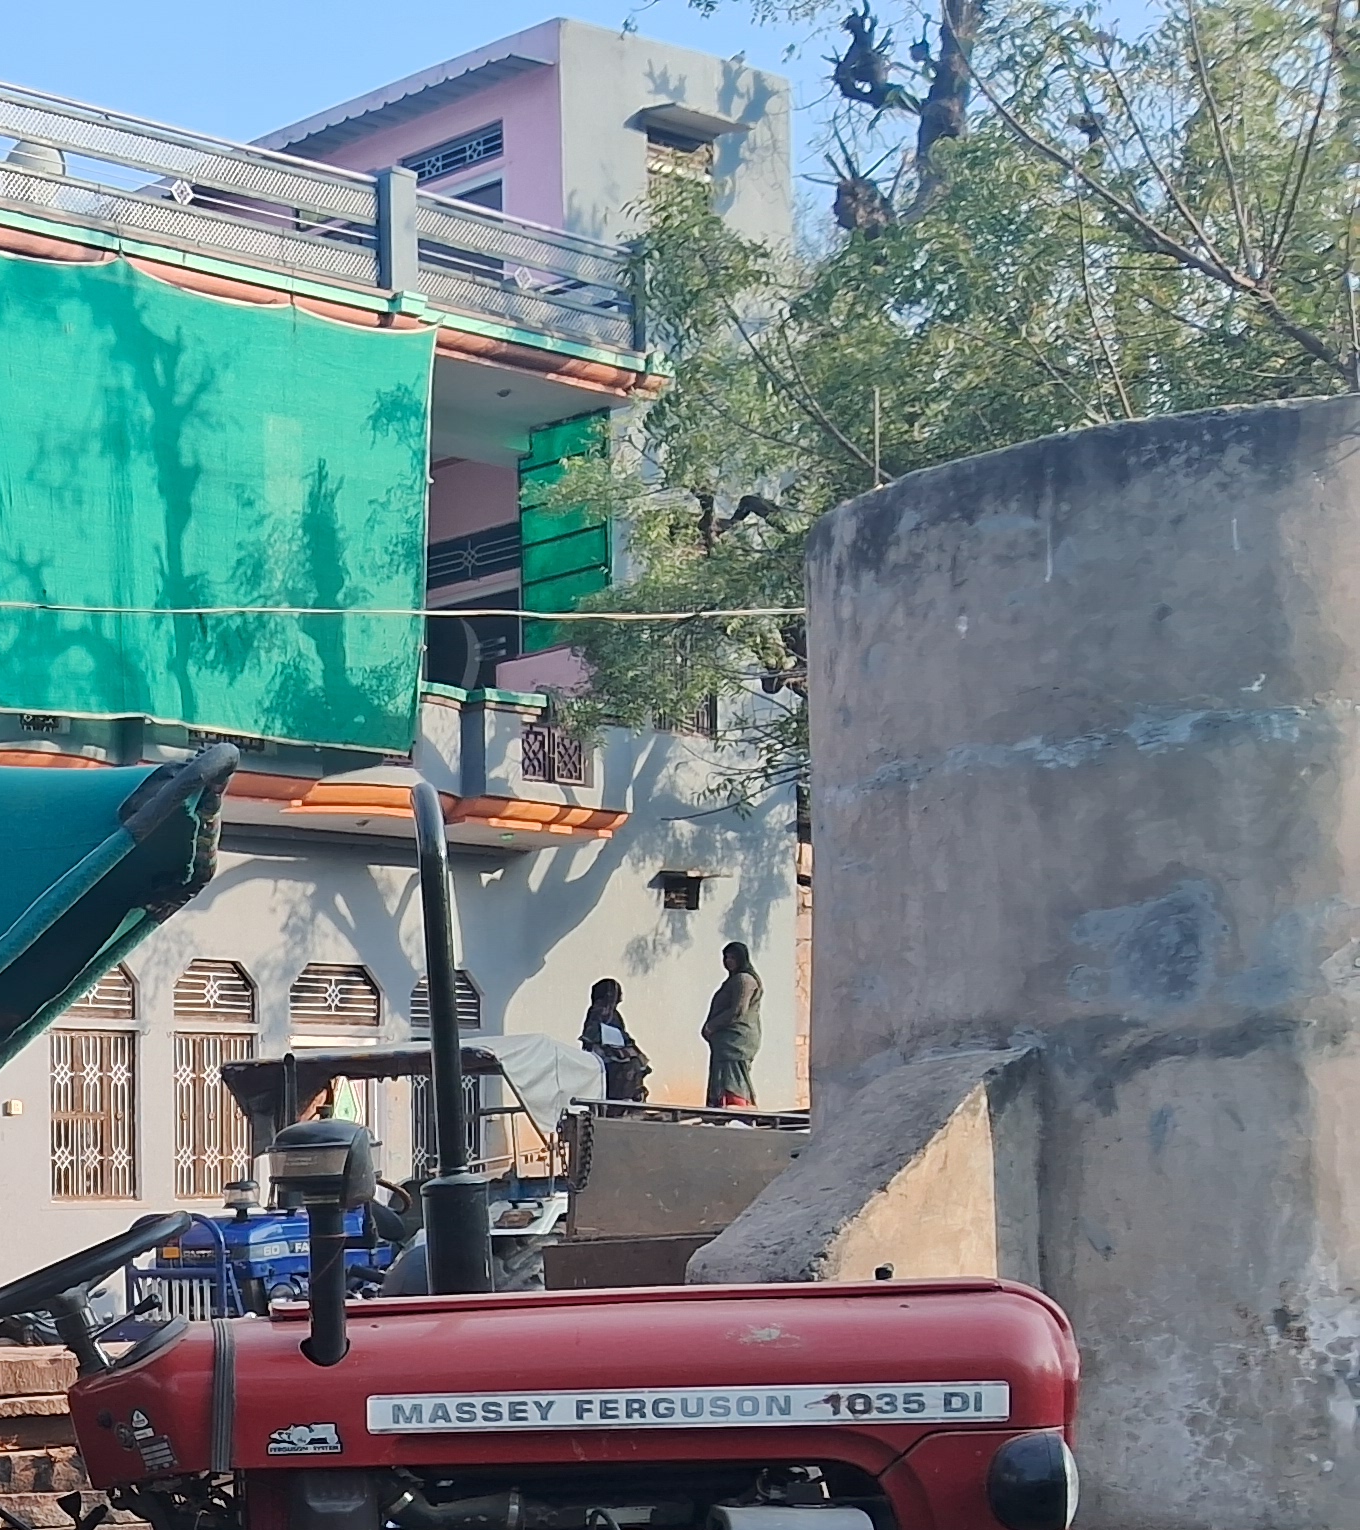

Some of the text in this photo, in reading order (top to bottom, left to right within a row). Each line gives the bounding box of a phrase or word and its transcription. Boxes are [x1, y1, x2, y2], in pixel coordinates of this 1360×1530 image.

[295, 1241, 310, 1253] FA
[391, 1391, 984, 1424] MASSEY FERGUSON 1035 DI
